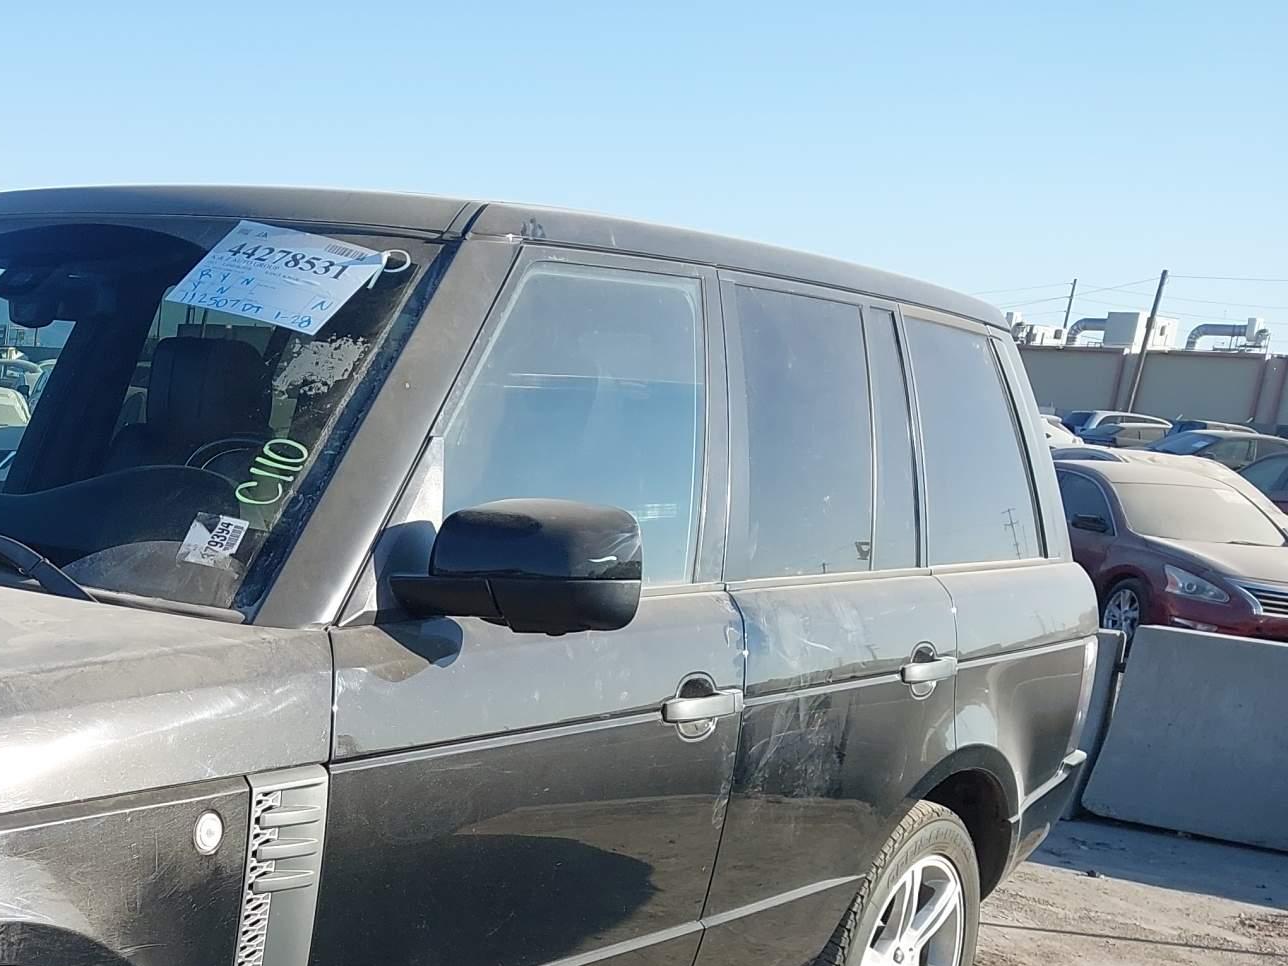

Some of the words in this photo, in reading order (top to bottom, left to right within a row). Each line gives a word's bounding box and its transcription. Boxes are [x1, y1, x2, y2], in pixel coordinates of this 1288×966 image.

[228, 242, 349, 281] 44278531
[240, 276, 255, 286] N
[216, 286, 231, 295] N
